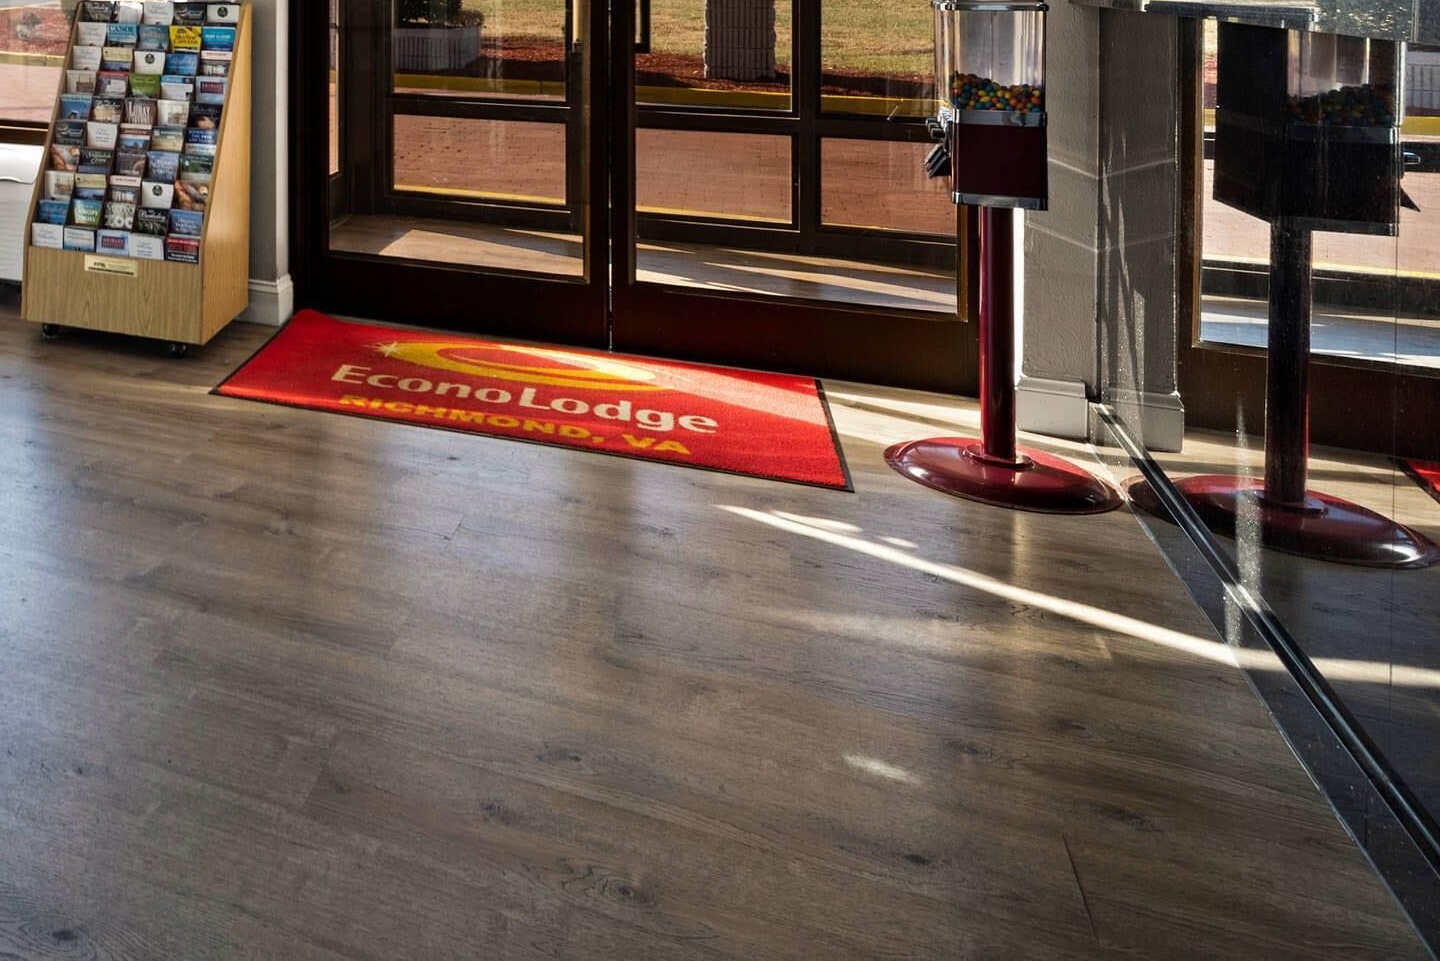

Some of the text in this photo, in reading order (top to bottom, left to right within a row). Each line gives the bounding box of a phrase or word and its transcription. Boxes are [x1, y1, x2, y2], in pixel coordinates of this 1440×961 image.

[331, 363, 719, 434] EconoLodge
[338, 394, 692, 455] RICHMOND, VA
